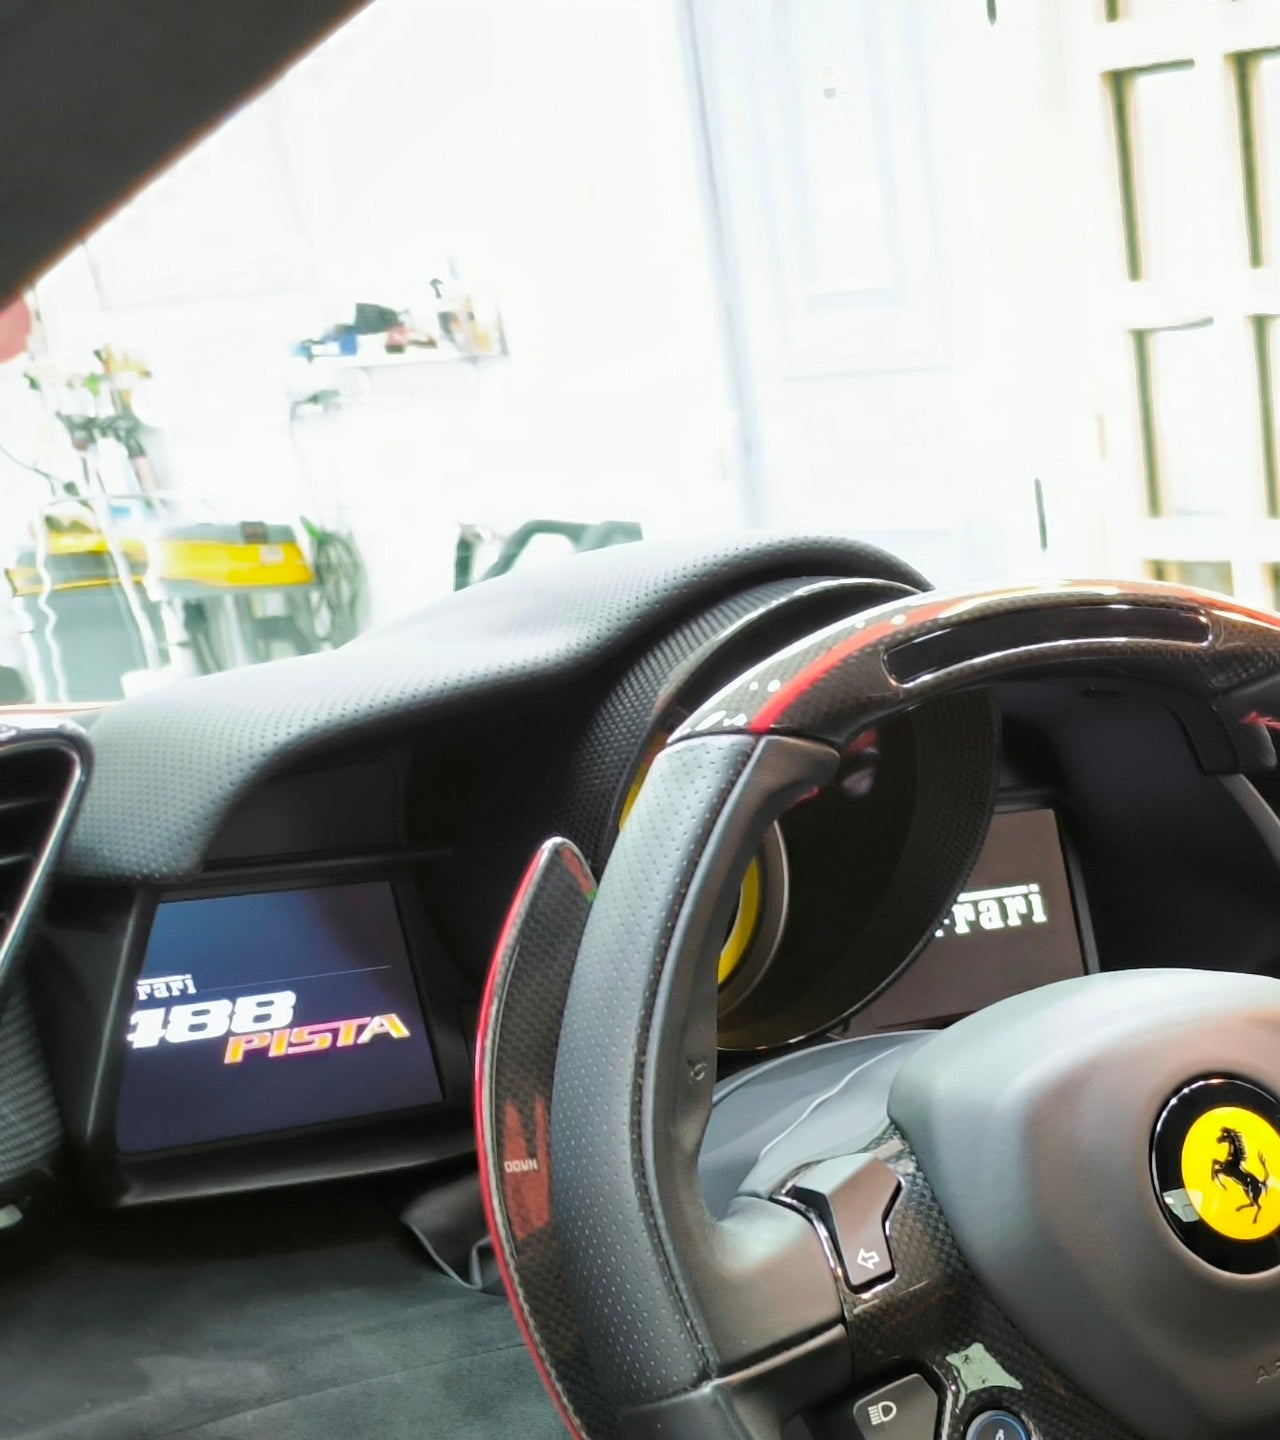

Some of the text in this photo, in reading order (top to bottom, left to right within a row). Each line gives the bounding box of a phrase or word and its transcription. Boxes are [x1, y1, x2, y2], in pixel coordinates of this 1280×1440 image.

[936, 884, 1048, 937] rari
[136, 974, 197, 1000] rari
[223, 1013, 411, 1065] PISTA
[503, 1158, 538, 1174] DOWN
